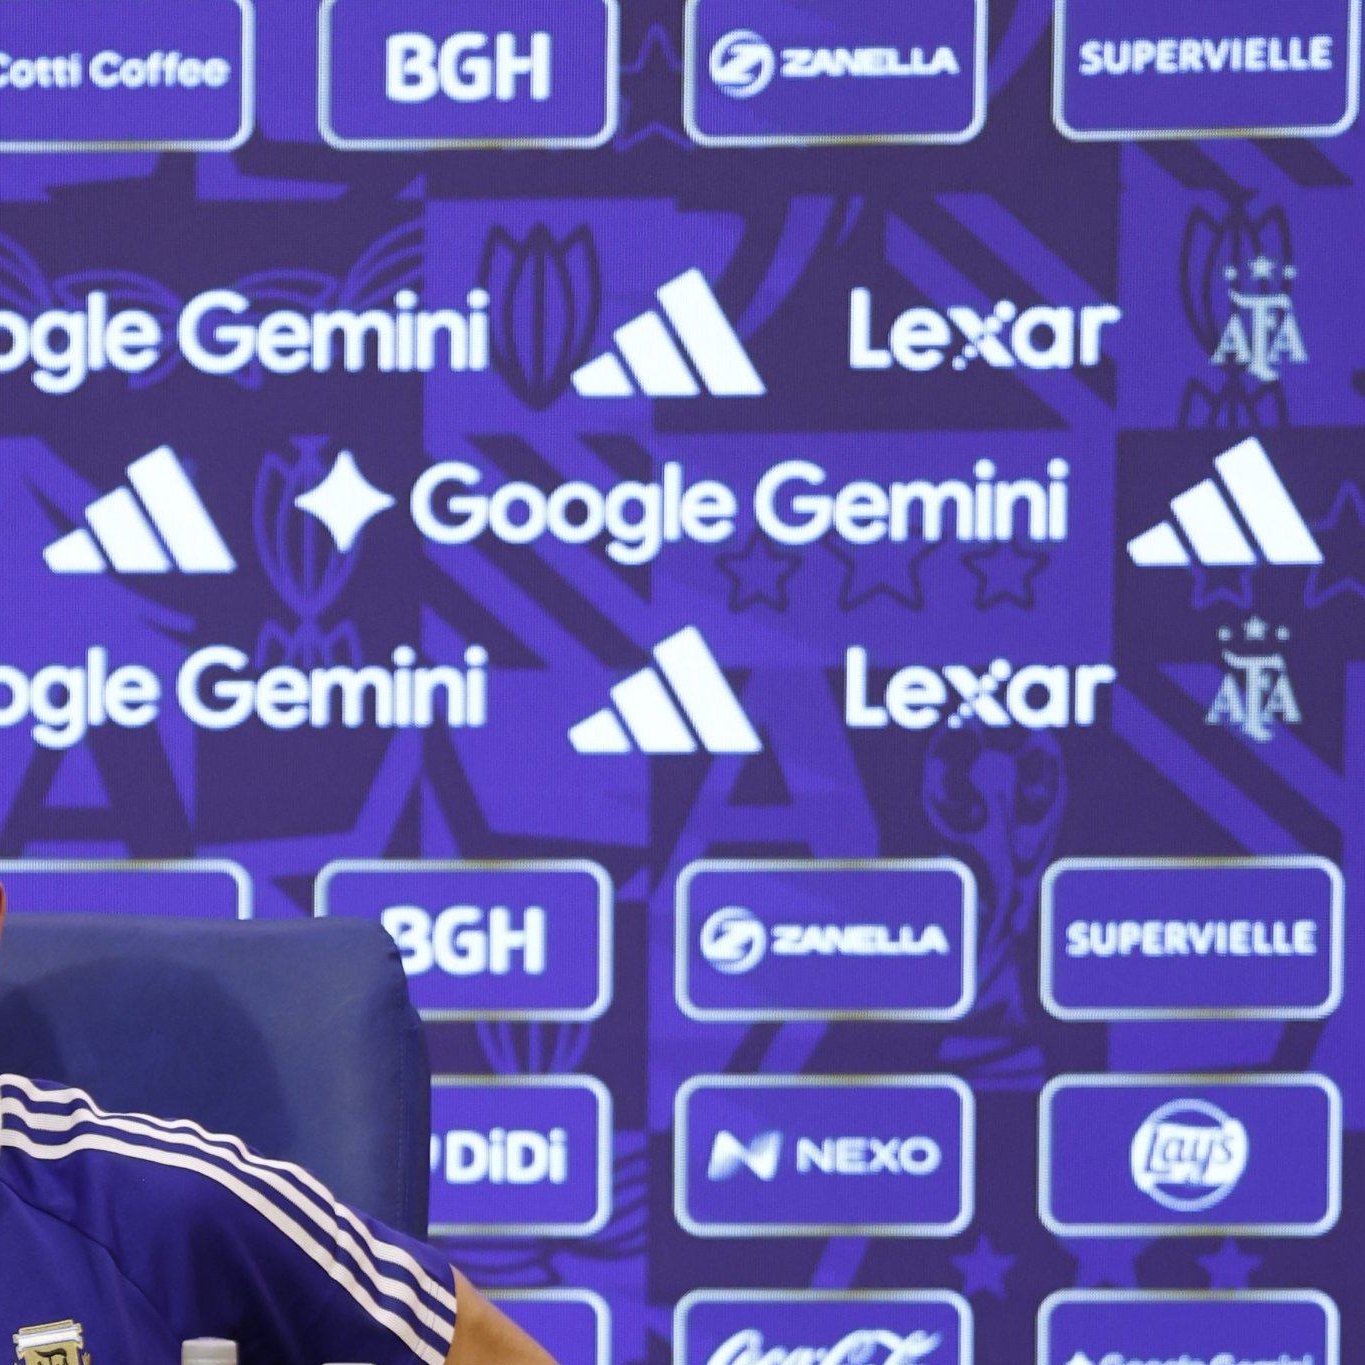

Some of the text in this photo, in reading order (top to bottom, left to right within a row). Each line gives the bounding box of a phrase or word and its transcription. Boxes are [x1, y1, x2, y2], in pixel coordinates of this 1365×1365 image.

[89, 50, 231, 88] Coffee
[386, 31, 551, 103] BGH
[780, 47, 959, 77] ZANELLA
[1079, 36, 1332, 75] SUPERVIELLE
[177, 288, 490, 374] Gemini
[850, 287, 1121, 371] Lexar
[410, 458, 1069, 565] Google Gemini
[176, 645, 488, 729] Gemini
[846, 645, 1116, 729] Lexar
[381, 905, 546, 975] BGH
[771, 924, 949, 955] ZANELLA
[1066, 920, 1316, 957] SUPERVIELLE
[446, 1127, 567, 1184] DiDi
[797, 1137, 941, 1175] NEXO
